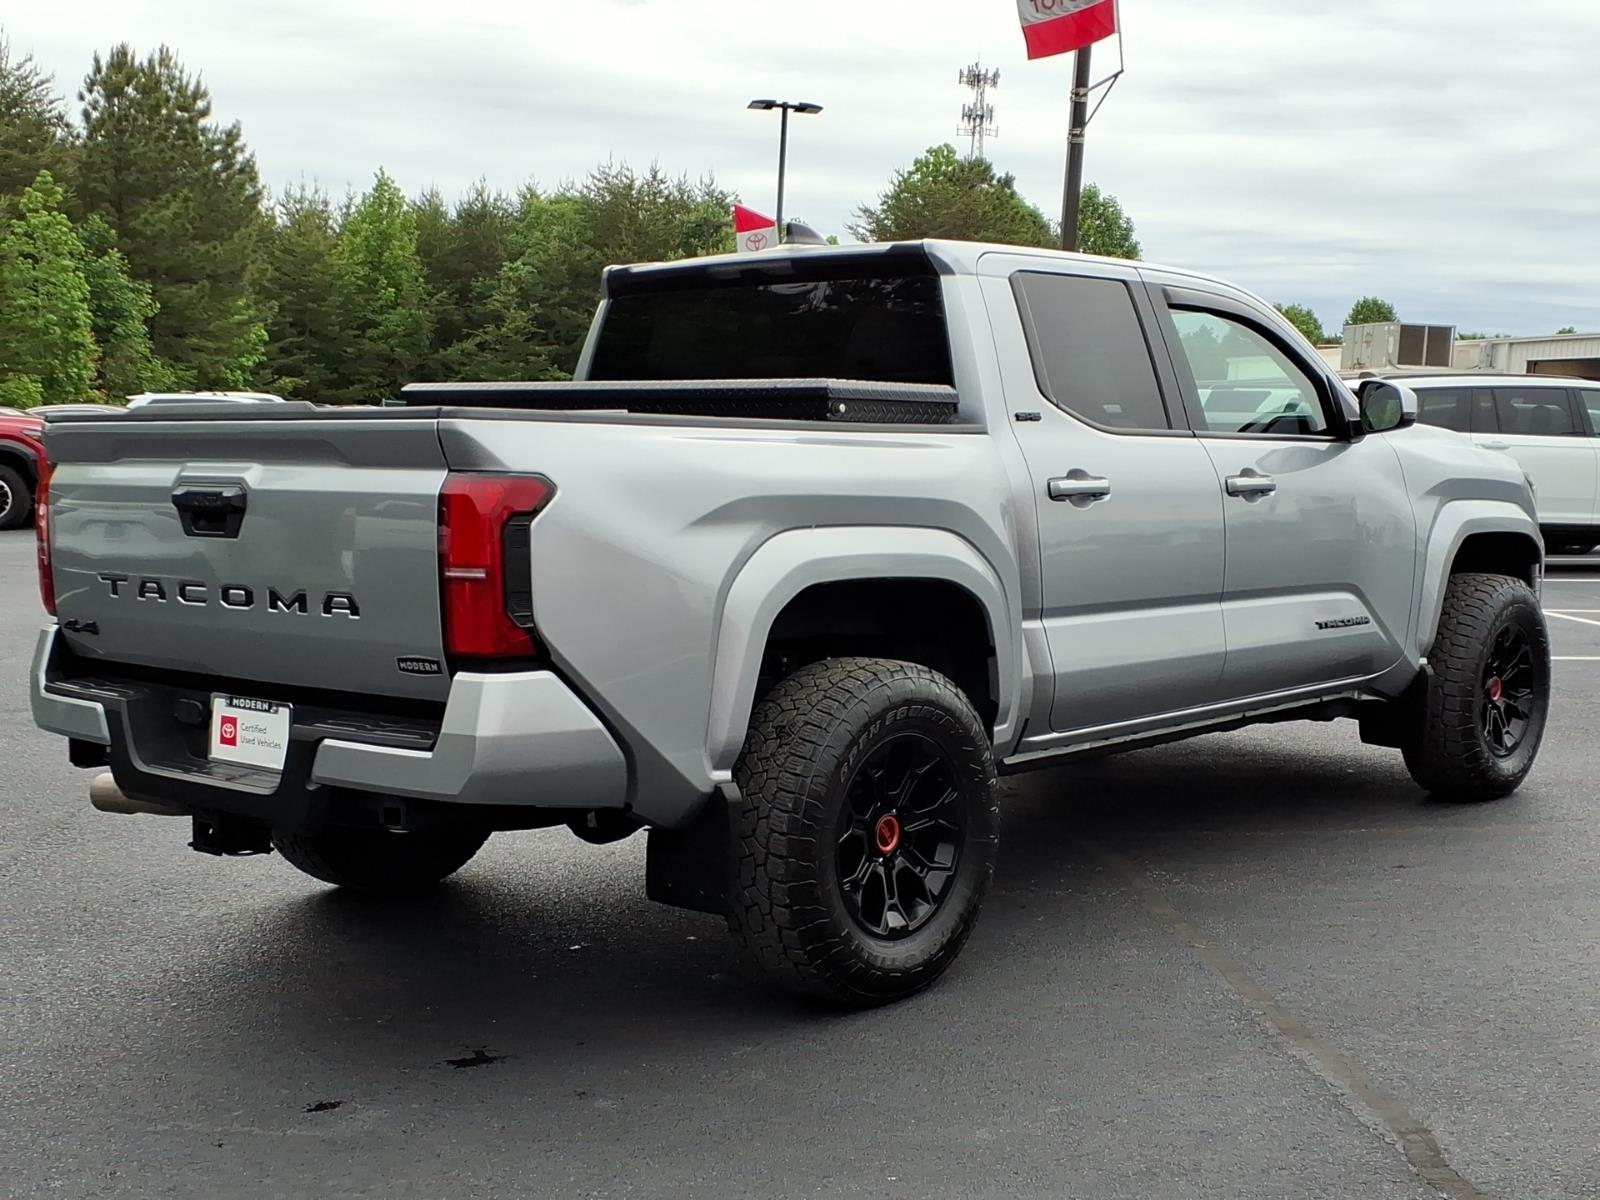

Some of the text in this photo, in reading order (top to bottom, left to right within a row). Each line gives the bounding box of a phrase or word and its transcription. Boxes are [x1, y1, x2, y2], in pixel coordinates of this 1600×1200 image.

[98, 574, 361, 619] TACOMA
[1315, 616, 1370, 630] TACOMA
[399, 661, 438, 671] MODERN
[232, 698, 269, 710] MODERN
[241, 722, 267, 735] Certified
[241, 736, 281, 750] Used Vehicles
